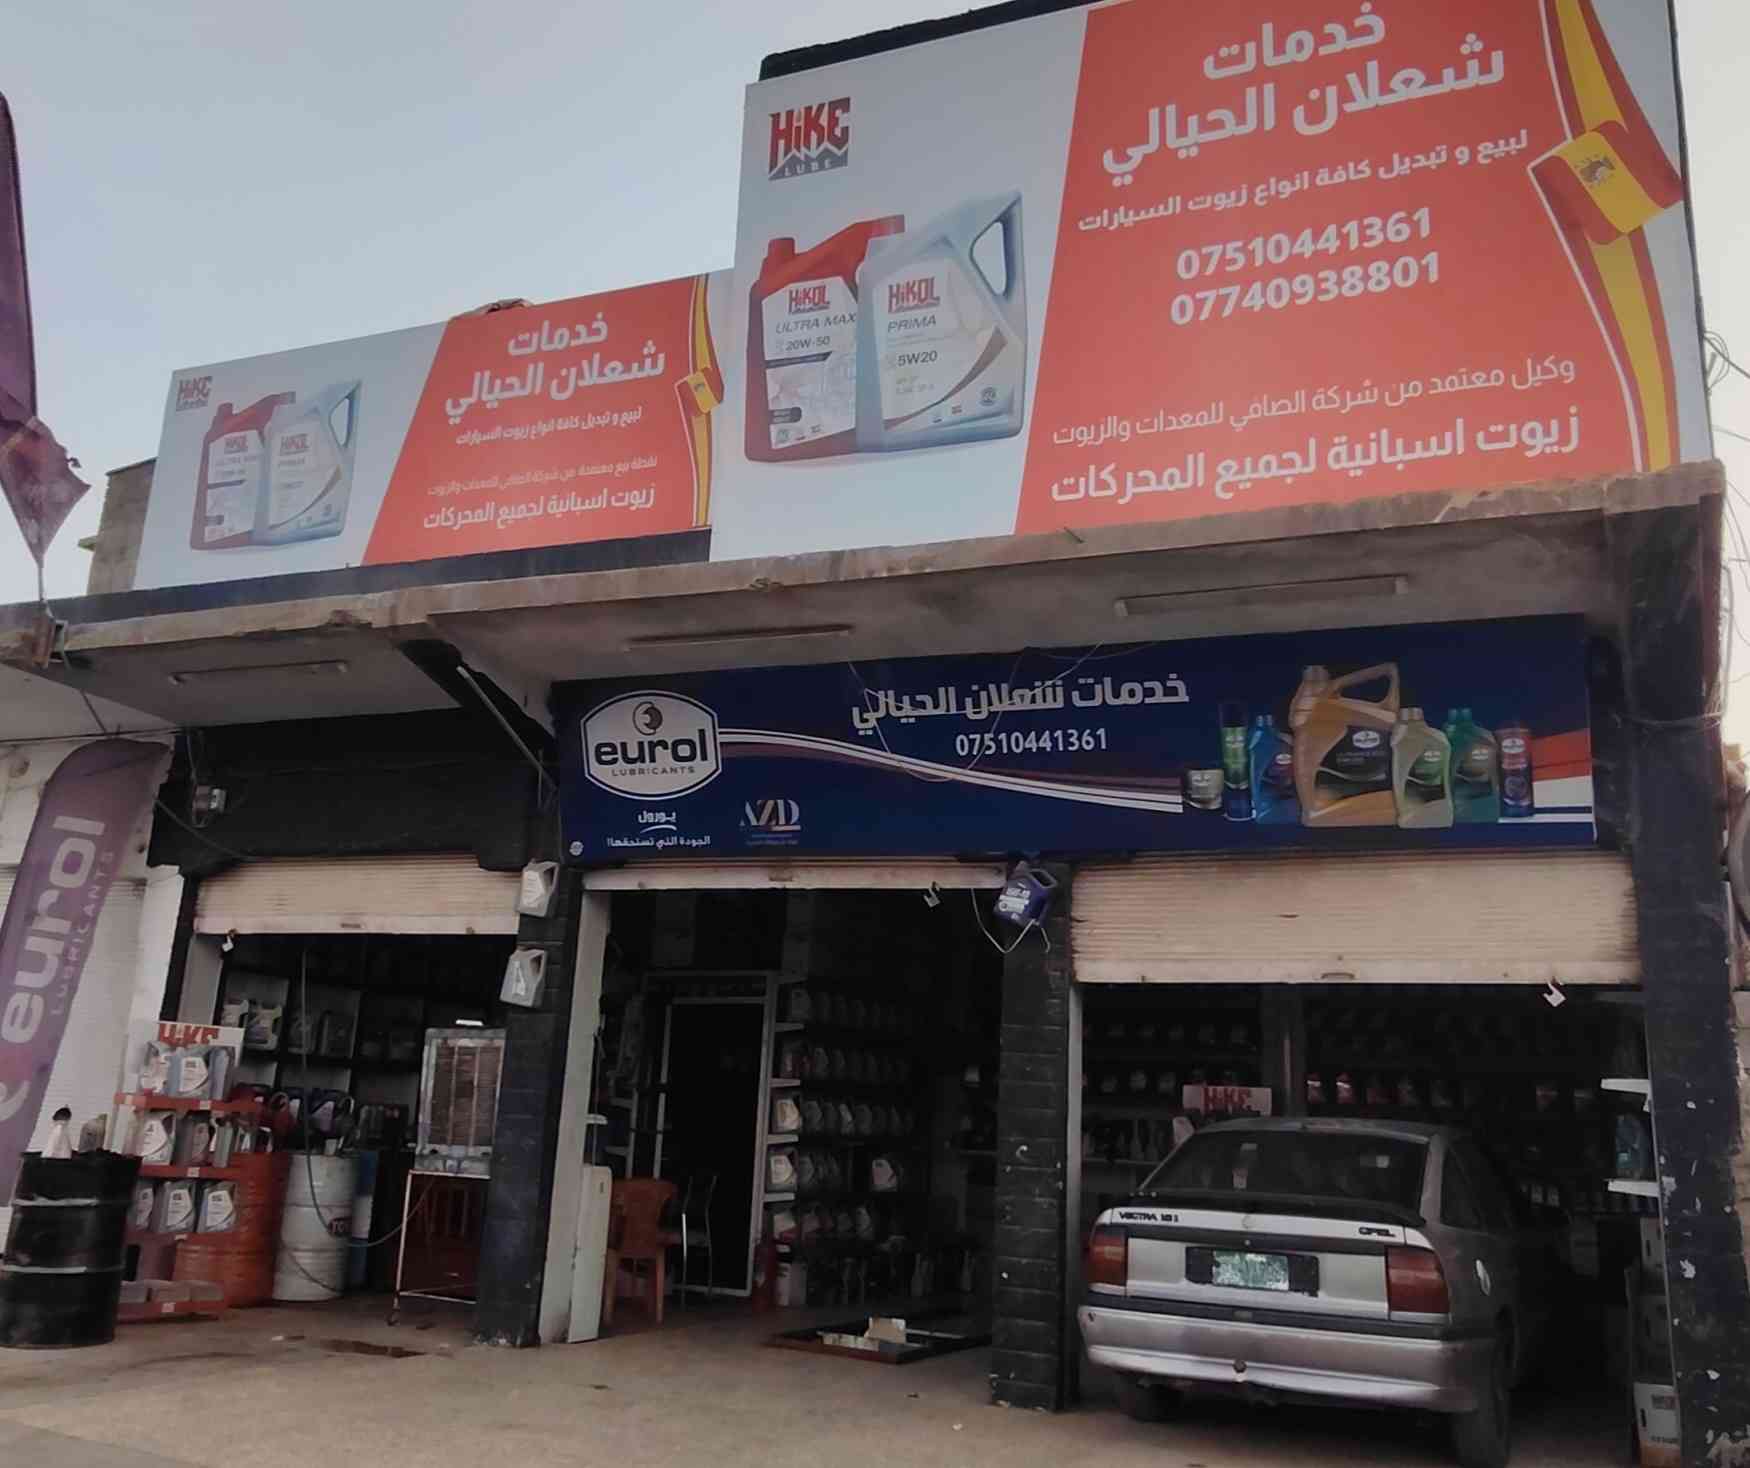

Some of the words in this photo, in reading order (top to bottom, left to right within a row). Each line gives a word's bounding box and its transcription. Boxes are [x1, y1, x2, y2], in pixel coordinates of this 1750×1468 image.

[1203, 1, 1386, 81] خدمات
[1293, 32, 1504, 136] شعلان
[1103, 83, 1275, 188] الحيالي
[1477, 128, 1528, 165] لبيع
[1315, 159, 1372, 187] كافة
[1378, 144, 1447, 180] تبديل
[1455, 145, 1470, 166] و
[1188, 184, 1249, 212] زيوت
[1254, 170, 1309, 207] انواع
[1078, 195, 1181, 231] السيارات
[1176, 207, 1431, 280] 07510441361
[1170, 251, 1439, 325] 07740938801
[508, 312, 608, 356] خدمات
[776, 318, 820, 334] ULTRA
[824, 312, 857, 327] MAX
[888, 315, 936, 333] PRIMA
[550, 339, 665, 400] شعلان
[898, 350, 938, 367] 5W20
[1511, 355, 1575, 389] وكيل
[445, 362, 544, 425] الحيالي
[1312, 378, 1378, 413] شركة
[1385, 379, 1423, 407] من
[1429, 367, 1505, 395] معتمد
[1136, 400, 1224, 434] للمعدات
[1230, 389, 1306, 431] الصافي
[1053, 415, 1130, 447] والزيوت
[1327, 417, 1465, 477] اسبانية
[1476, 405, 1580, 458] زيوت
[1051, 452, 1205, 504] المحركات
[1215, 437, 1316, 500] لجميع
[497, 495, 544, 528] لجميع
[547, 488, 608, 518] اسبانية
[611, 482, 654, 511] زيوت
[424, 501, 496, 530] المحركات
[965, 680, 1064, 719] شعلان
[1071, 673, 1189, 708] خدمات
[852, 686, 955, 735] الحيالي
[594, 729, 708, 765] eurol
[955, 728, 1107, 756] 07510441361
[611, 766, 696, 777] LUBRICANTS
[1, 815, 106, 1044] eurol
[1119, 1211, 1158, 1221] VECTRA
